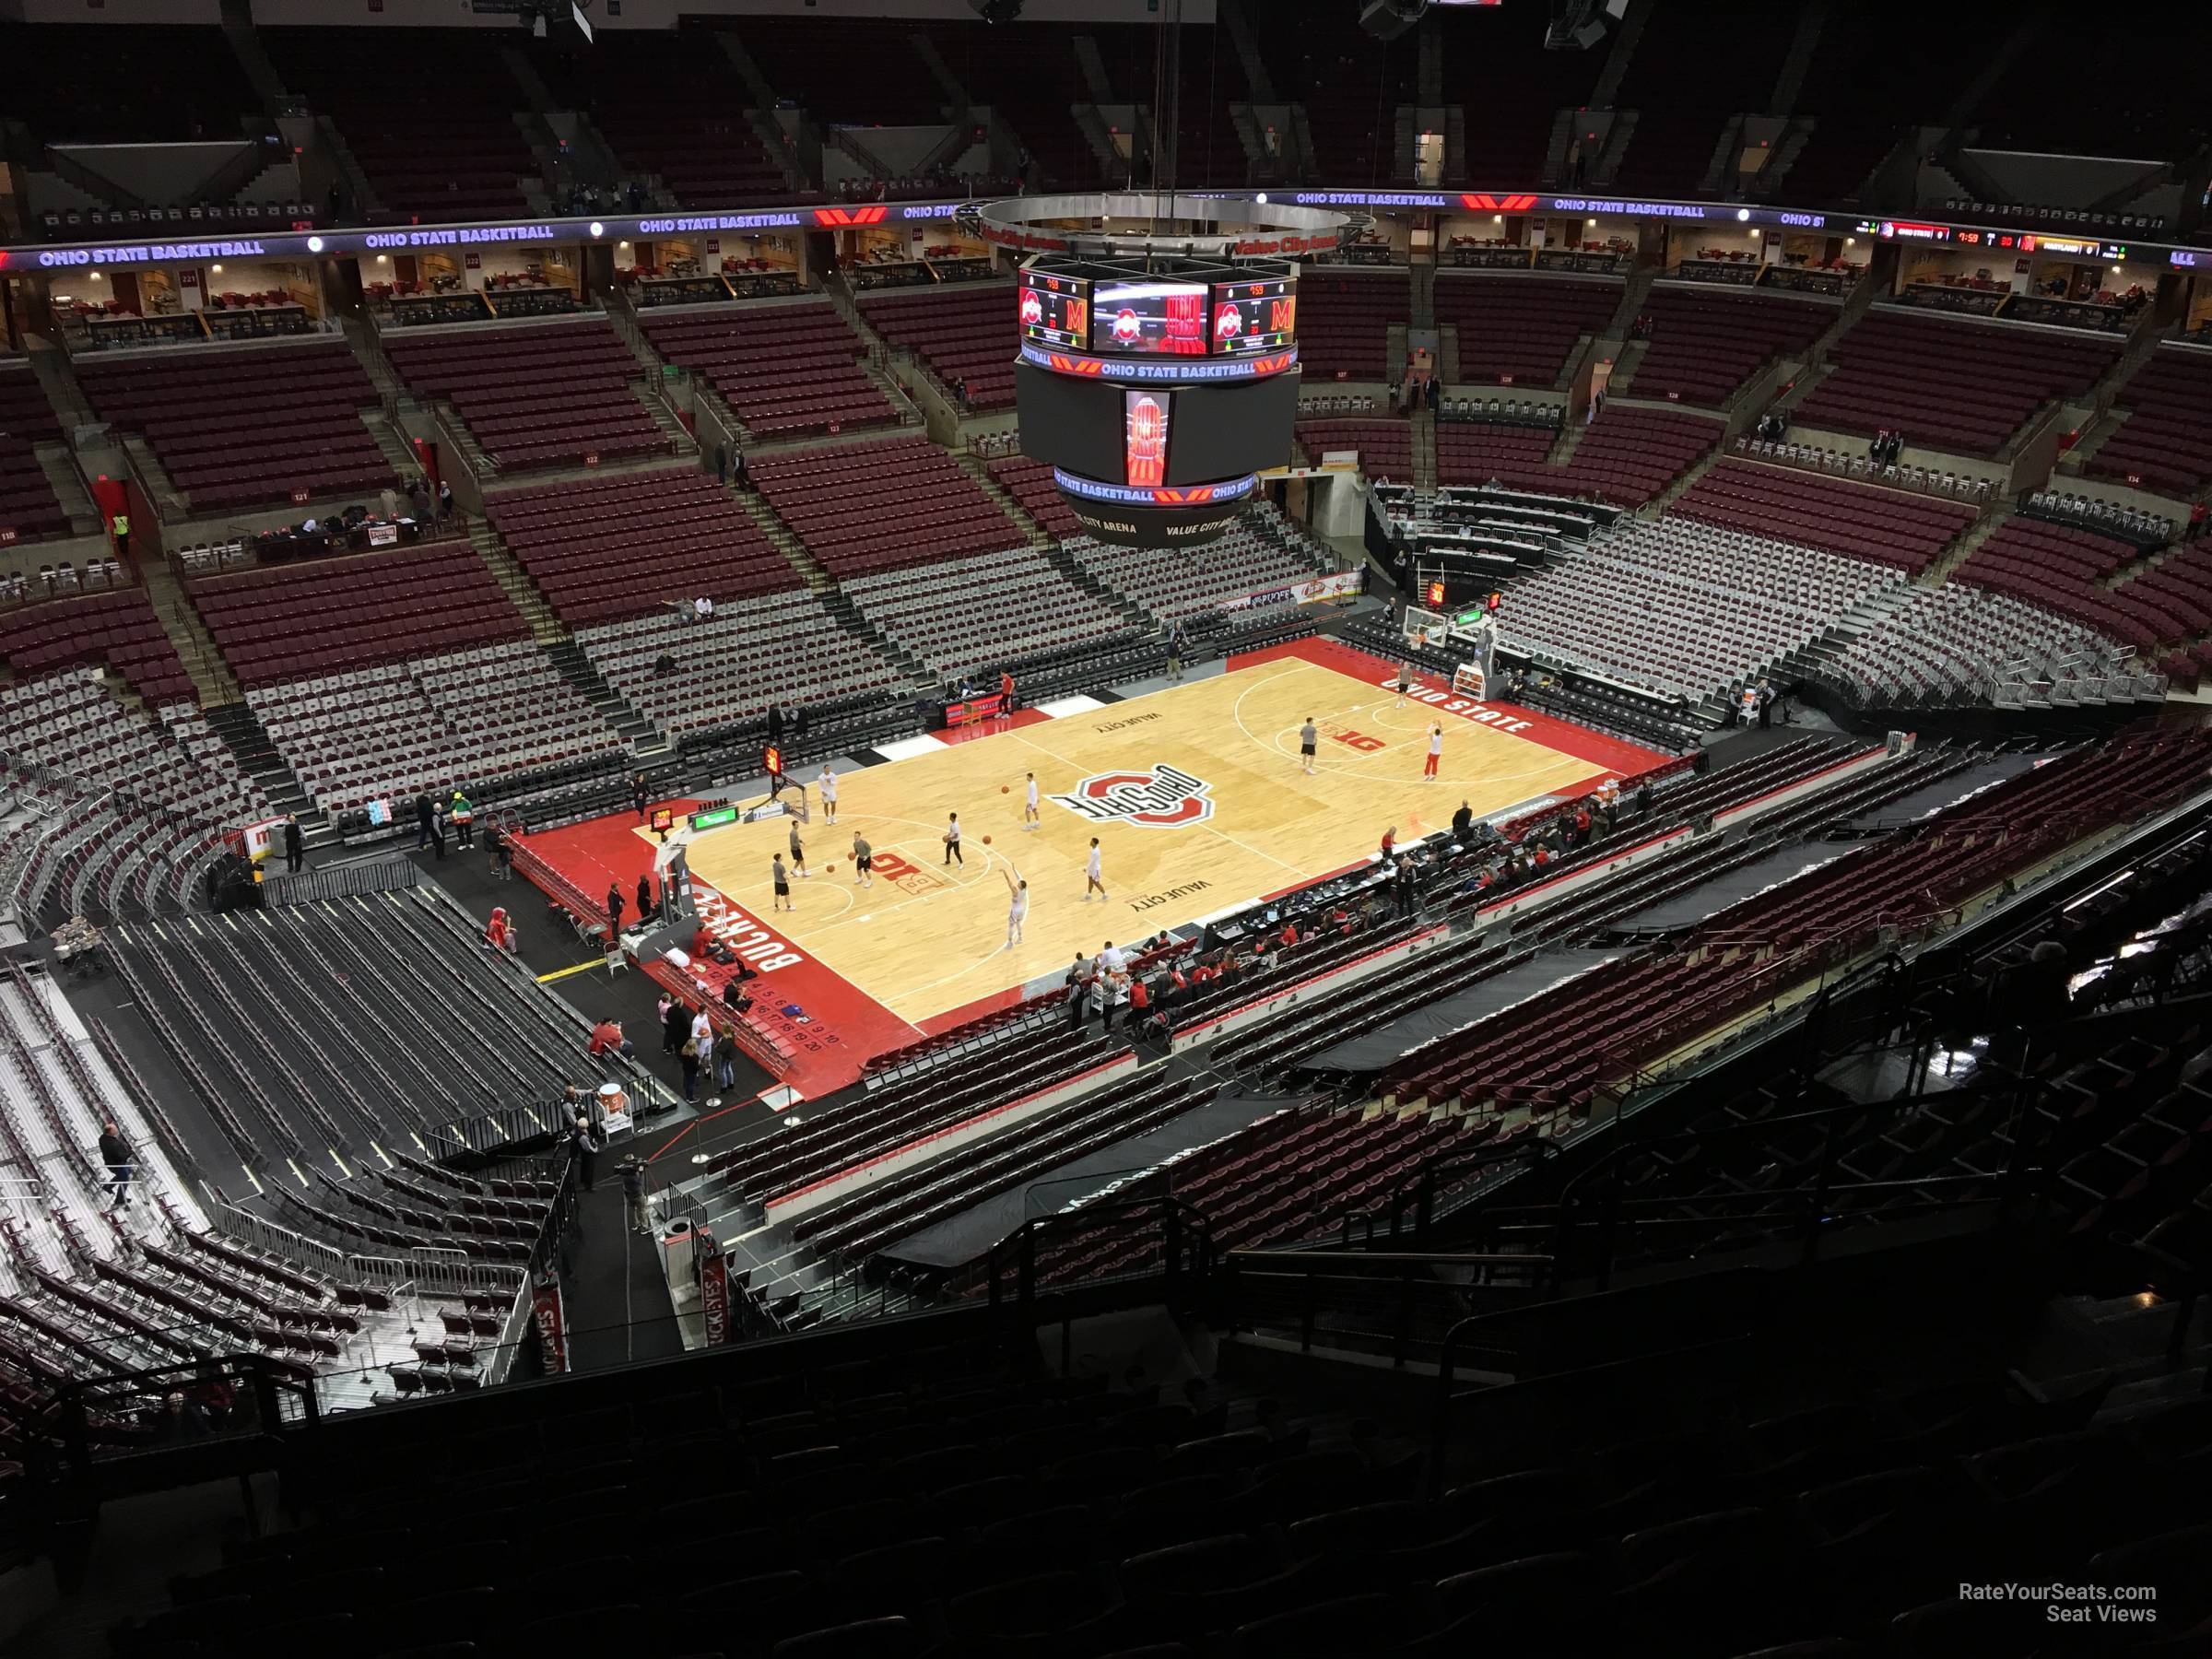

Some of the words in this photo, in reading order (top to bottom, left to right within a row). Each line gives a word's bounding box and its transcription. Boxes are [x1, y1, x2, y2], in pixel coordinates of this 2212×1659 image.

[1297, 193, 1327, 204] OHIO
[1329, 194, 1365, 205] STATE
[1368, 194, 1445, 206] BASKETBALL
[1554, 199, 1585, 210] OHIO
[1587, 201, 1624, 213] STATE
[1626, 203, 1705, 218] BASKETBALL
[903, 206, 932, 218] OHIO
[934, 205, 959, 217] STA
[1781, 213, 1811, 227] OHIO
[640, 220, 675, 233] OHIO
[677, 218, 717, 230] STATE
[720, 213, 800, 229] BASKETBALL
[366, 234, 407, 248] OHIO
[410, 230, 456, 245] STATE
[460, 226, 554, 243] BASKETBALL
[1234, 239, 1279, 255] Value
[1281, 236, 1308, 254] City
[1959, 232, 1979, 243] 7:59
[39, 249, 89, 266] OHIO
[92, 246, 149, 264] STATE
[151, 241, 265, 260] BASKETBALL
[182, 275, 196, 283] 221
[1249, 285, 1265, 296] 7:59
[1066, 300, 1085, 333] M
[1271, 300, 1292, 331] M
[1101, 363, 1135, 377] OHIO
[1137, 366, 1178, 378] STATE
[1181, 364, 1255, 378] BASKETBALL
[586, 455, 598, 464] 122
[294, 493, 308, 501] 121
[1081, 483, 1155, 501] BASKETBALL
[1212, 485, 1237, 498] OHIO
[1085, 516, 1101, 528] CITY
[1103, 521, 1137, 534] ARENA
[1166, 524, 1199, 535] VALUE
[1199, 520, 1221, 532] CITY
[1123, 712, 1163, 726] VALUE
[1443, 699, 1535, 733] STATE
[1096, 720, 1125, 735] CITY
[1162, 879, 1213, 900] VALUE
[1130, 895, 1166, 913] CITY
[794, 1031, 807, 1041] 19
[805, 1041, 822, 1052] 20
[812, 1025, 825, 1033] 9
[824, 1034, 840, 1044] 10
[703, 1277, 725, 1345] UCKEYES
[536, 1309, 559, 1375] UCKEYES
